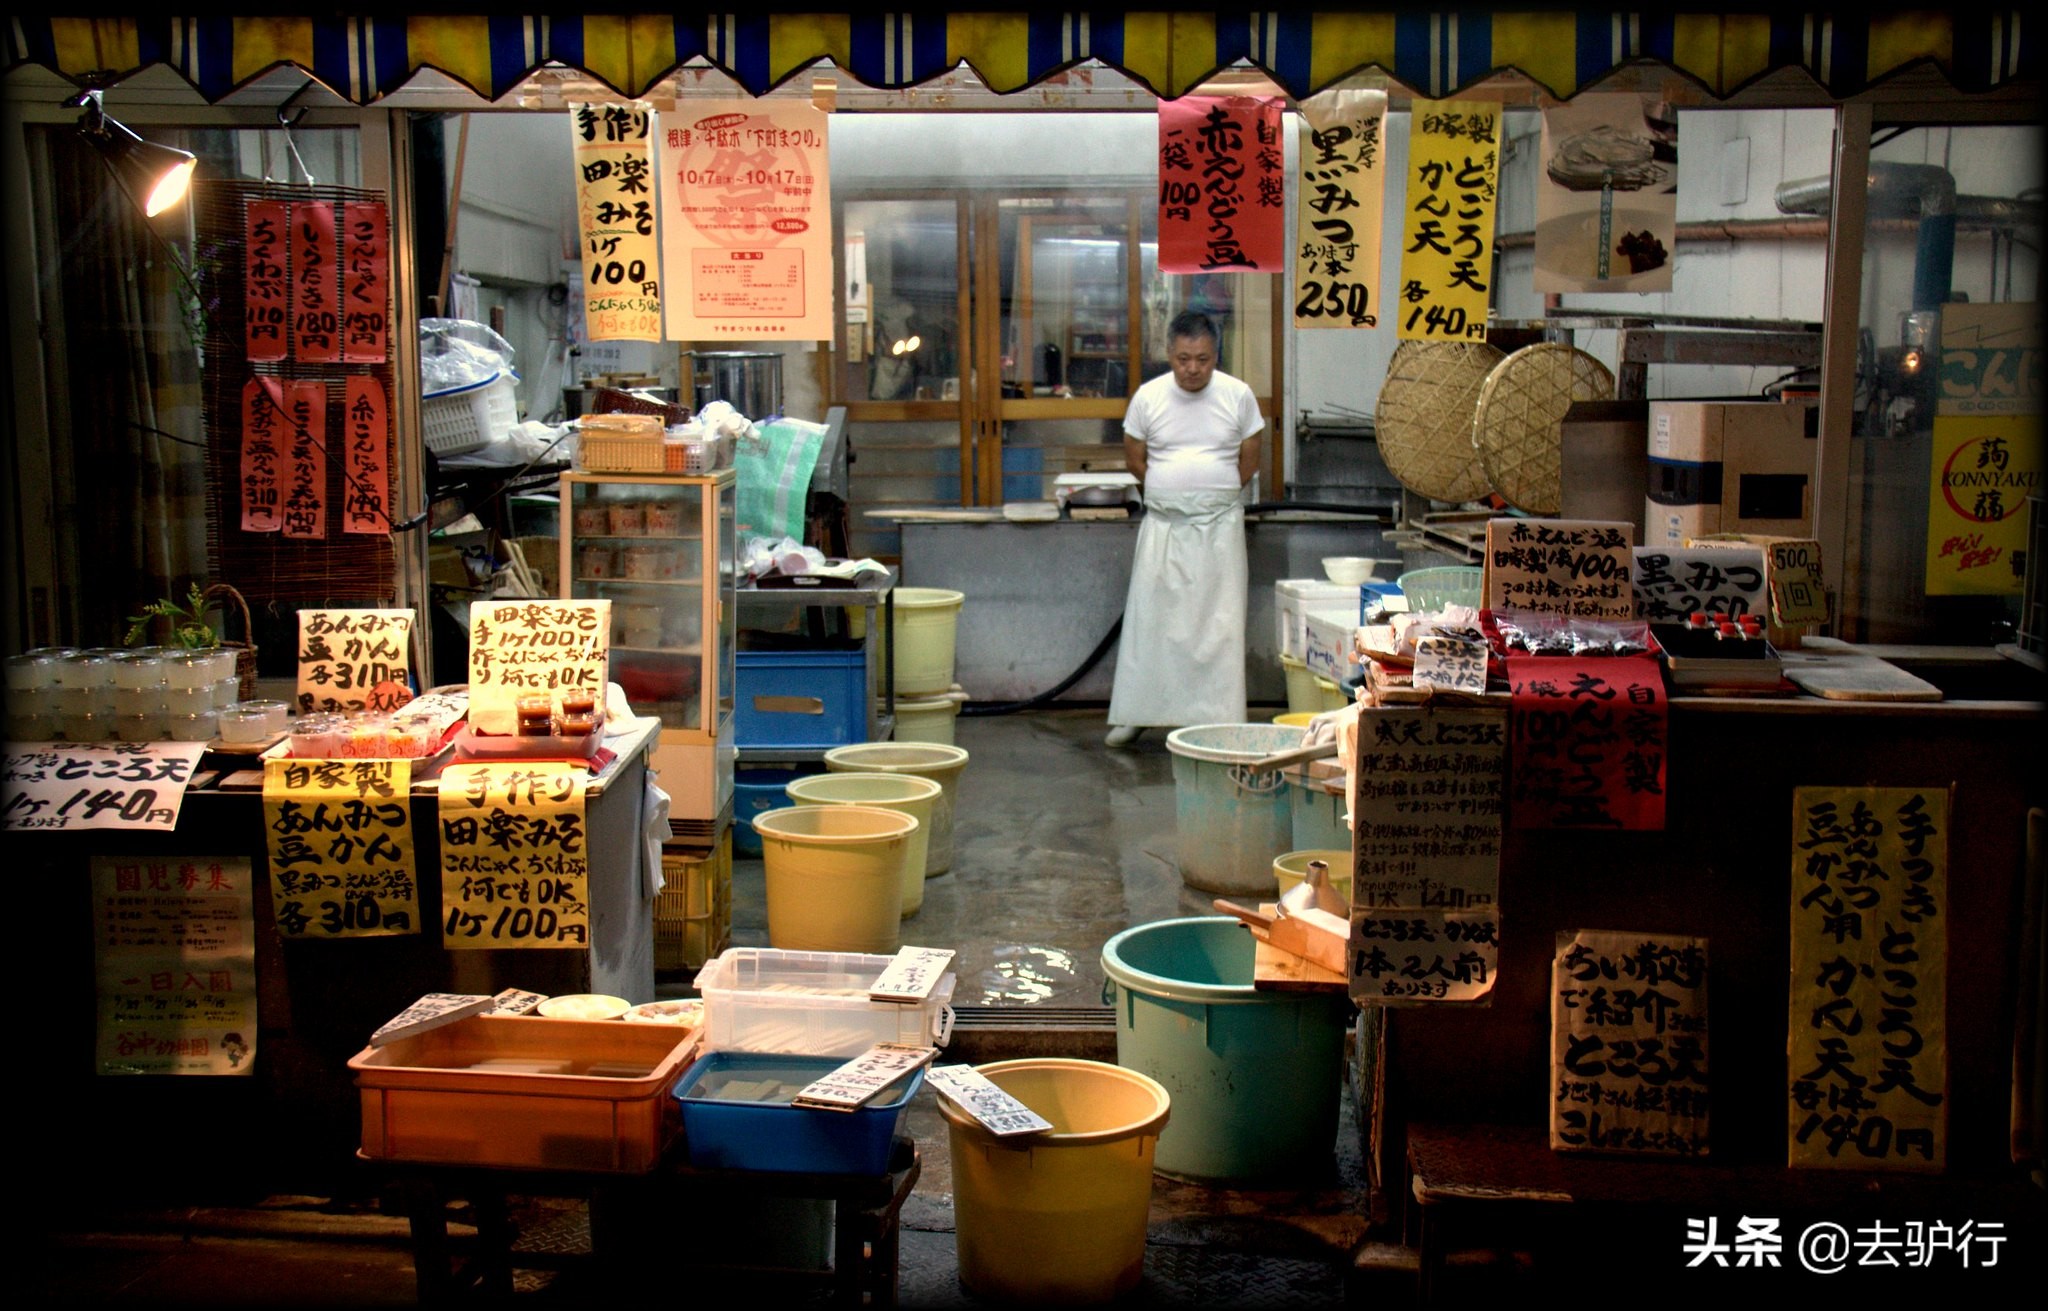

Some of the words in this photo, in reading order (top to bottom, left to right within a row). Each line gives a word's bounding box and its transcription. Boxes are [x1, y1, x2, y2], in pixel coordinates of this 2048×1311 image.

[578, 103, 650, 143] 手作り
[1355, 116, 1380, 169] 濃厚
[1421, 113, 1496, 144] 自家製
[1161, 129, 1195, 171] 一袋
[1255, 119, 1284, 208] 自家製
[582, 153, 650, 195] 田楽
[1196, 105, 1258, 270] 赤えんどう豆
[1305, 126, 1360, 244] 黒みつ
[596, 200, 654, 236] みそ
[1161, 181, 1201, 221] 100円
[1406, 159, 1454, 256] かん天
[1446, 156, 1487, 292] ところ天
[249, 218, 282, 299] ちくわぶ
[300, 223, 322, 309] しらたき
[351, 221, 377, 303] こんにゃく
[591, 259, 659, 299] 100円
[247, 307, 284, 339] 110円
[1296, 281, 1377, 327] 250円
[1406, 304, 1486, 340] 140円
[295, 313, 336, 349] 180円
[344, 312, 384, 346] 150円
[1942, 471, 2039, 487] KONNYAKU
[1509, 522, 1627, 549] 赤えんどう豆
[1633, 554, 1762, 598] 黒みつ
[1776, 548, 1821, 578] 500円
[305, 613, 410, 635] あんみつ
[494, 604, 597, 630] 田楽みそ
[299, 636, 400, 663] 豆かん
[472, 619, 496, 684] 手作り
[501, 667, 599, 689] 何でもOK
[1622, 684, 1662, 795] 自家製
[56, 757, 189, 783] ところ天
[285, 761, 394, 797] 自家製
[466, 768, 575, 808] 手作り
[273, 800, 406, 834] あんみつ
[444, 808, 583, 853] 田楽みそ
[274, 833, 402, 868] 豆かん
[1798, 802, 1848, 915] 豆かん
[1838, 801, 1890, 908] あんみつ
[275, 870, 342, 898] 黒みつ
[460, 876, 577, 903] 何でもOK
[278, 898, 411, 935] 各310円
[1382, 980, 1450, 998] あります
[1560, 987, 1680, 1033] で紹介
[1804, 955, 1875, 1088] かん天
[1870, 921, 1943, 1107] ところ天
[1565, 1034, 1710, 1085] ところ天
